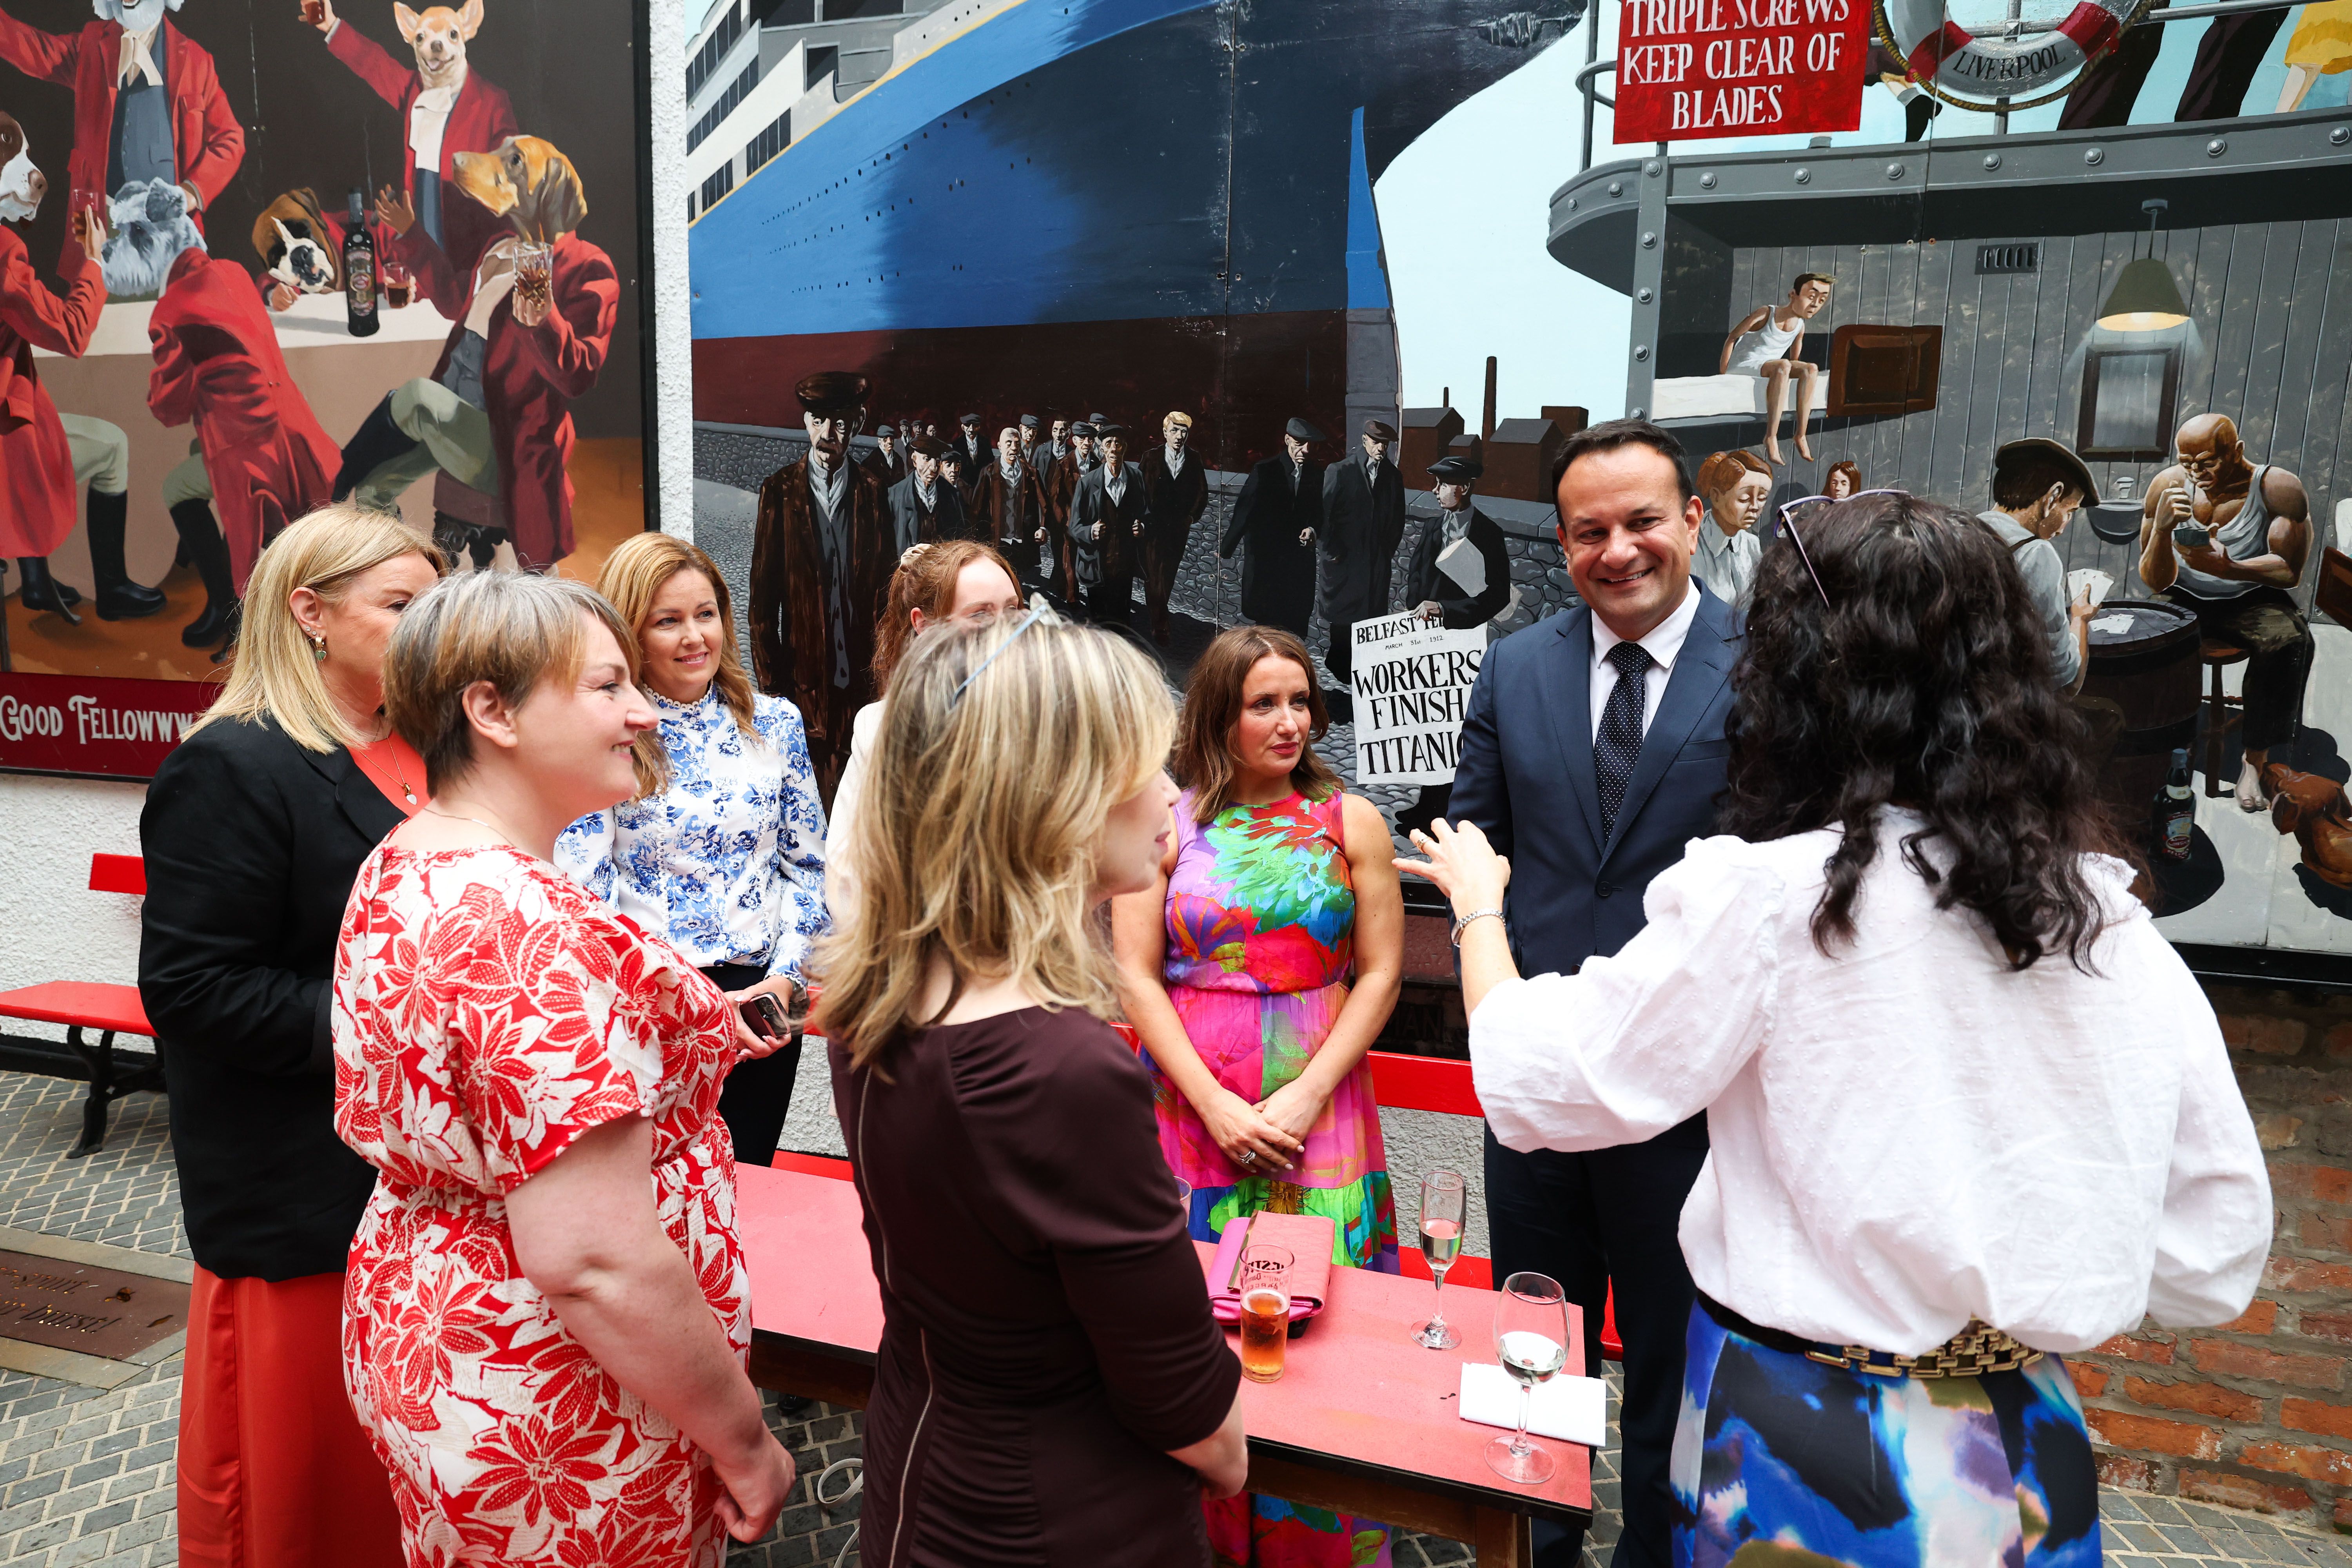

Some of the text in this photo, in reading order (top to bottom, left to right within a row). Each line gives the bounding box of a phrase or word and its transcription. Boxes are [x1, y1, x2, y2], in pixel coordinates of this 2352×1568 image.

[1626, 0, 1849, 37] TRIPLE SCREWS
[1622, 32, 1845, 85] KEEP CLEAR OF
[1953, 45, 2066, 80] LIVERPOOL
[1671, 85, 1783, 130] BLADES
[1356, 617, 1417, 644] BELFAST
[1352, 650, 1482, 699] WORKERS
[1370, 688, 1465, 731] FINISH
